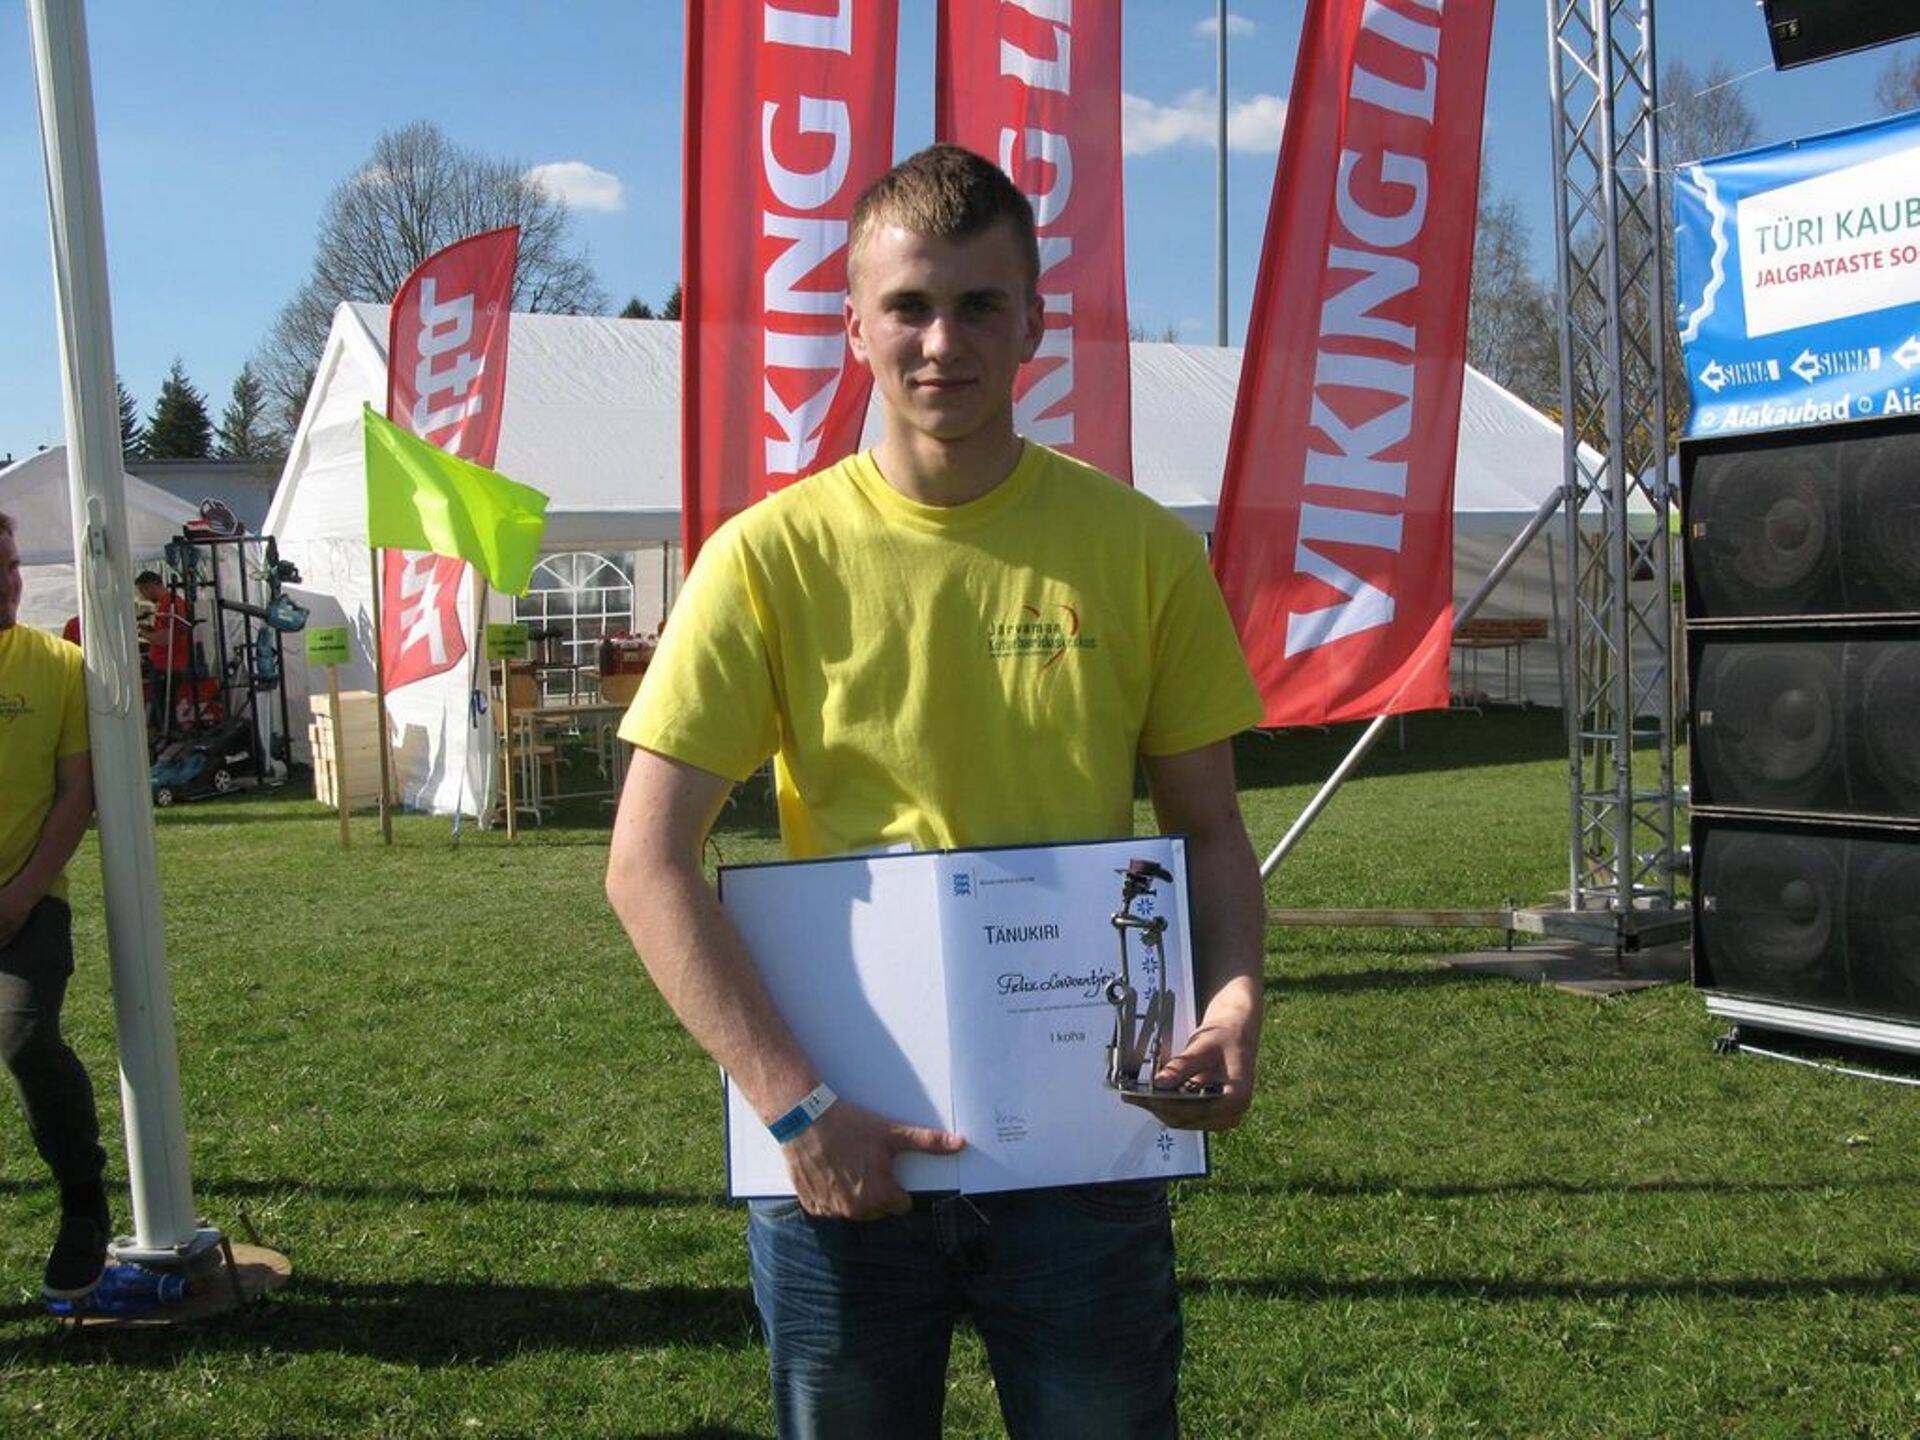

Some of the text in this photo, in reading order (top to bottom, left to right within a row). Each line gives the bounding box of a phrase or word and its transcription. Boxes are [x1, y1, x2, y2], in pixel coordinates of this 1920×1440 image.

[1755, 197, 1920, 255] TÜRI KAUB
[1755, 244, 1918, 288] JALGRATASTE SO
[763, 96, 852, 495] KING
[1284, 0, 1444, 659] VIKING LI
[1720, 393, 1850, 430] Aiakaubad
[984, 924, 1060, 945] TÄNUKIRI
[997, 973, 1039, 996] Felix
[1056, 1030, 1086, 1043] koha
